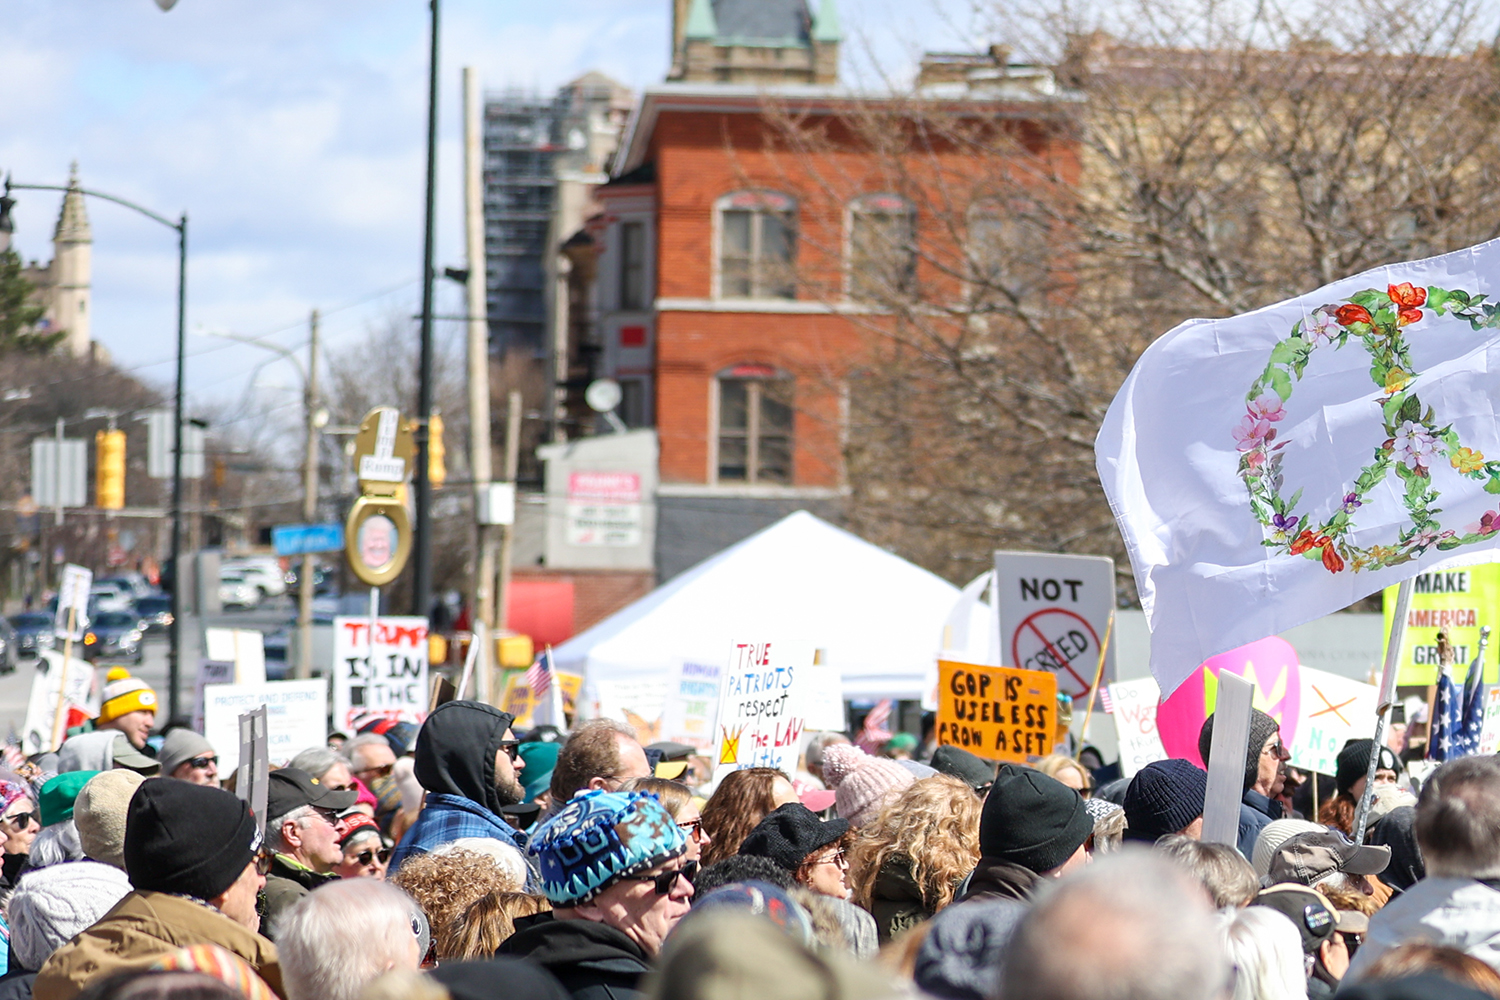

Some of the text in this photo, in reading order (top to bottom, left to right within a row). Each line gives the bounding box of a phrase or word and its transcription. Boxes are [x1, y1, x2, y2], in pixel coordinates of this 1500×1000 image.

[1020, 578, 1083, 602] NOT
[1414, 572, 1466, 594] MAKE
[1408, 610, 1476, 628] AMERICA
[387, 654, 421, 679] IN
[736, 643, 772, 670] TRUE
[1414, 646, 1467, 665] GRAT
[727, 665, 794, 697] PATRIOTS
[951, 670, 1022, 702] GOP IS
[1116, 686, 1138, 701] Do
[214, 691, 318, 707] PROTECT AND DEFEND
[738, 690, 789, 725] respect
[954, 698, 1049, 730] USELESS
[750, 728, 769, 751] the
[939, 722, 982, 748] GROW
[1309, 727, 1337, 753] No
